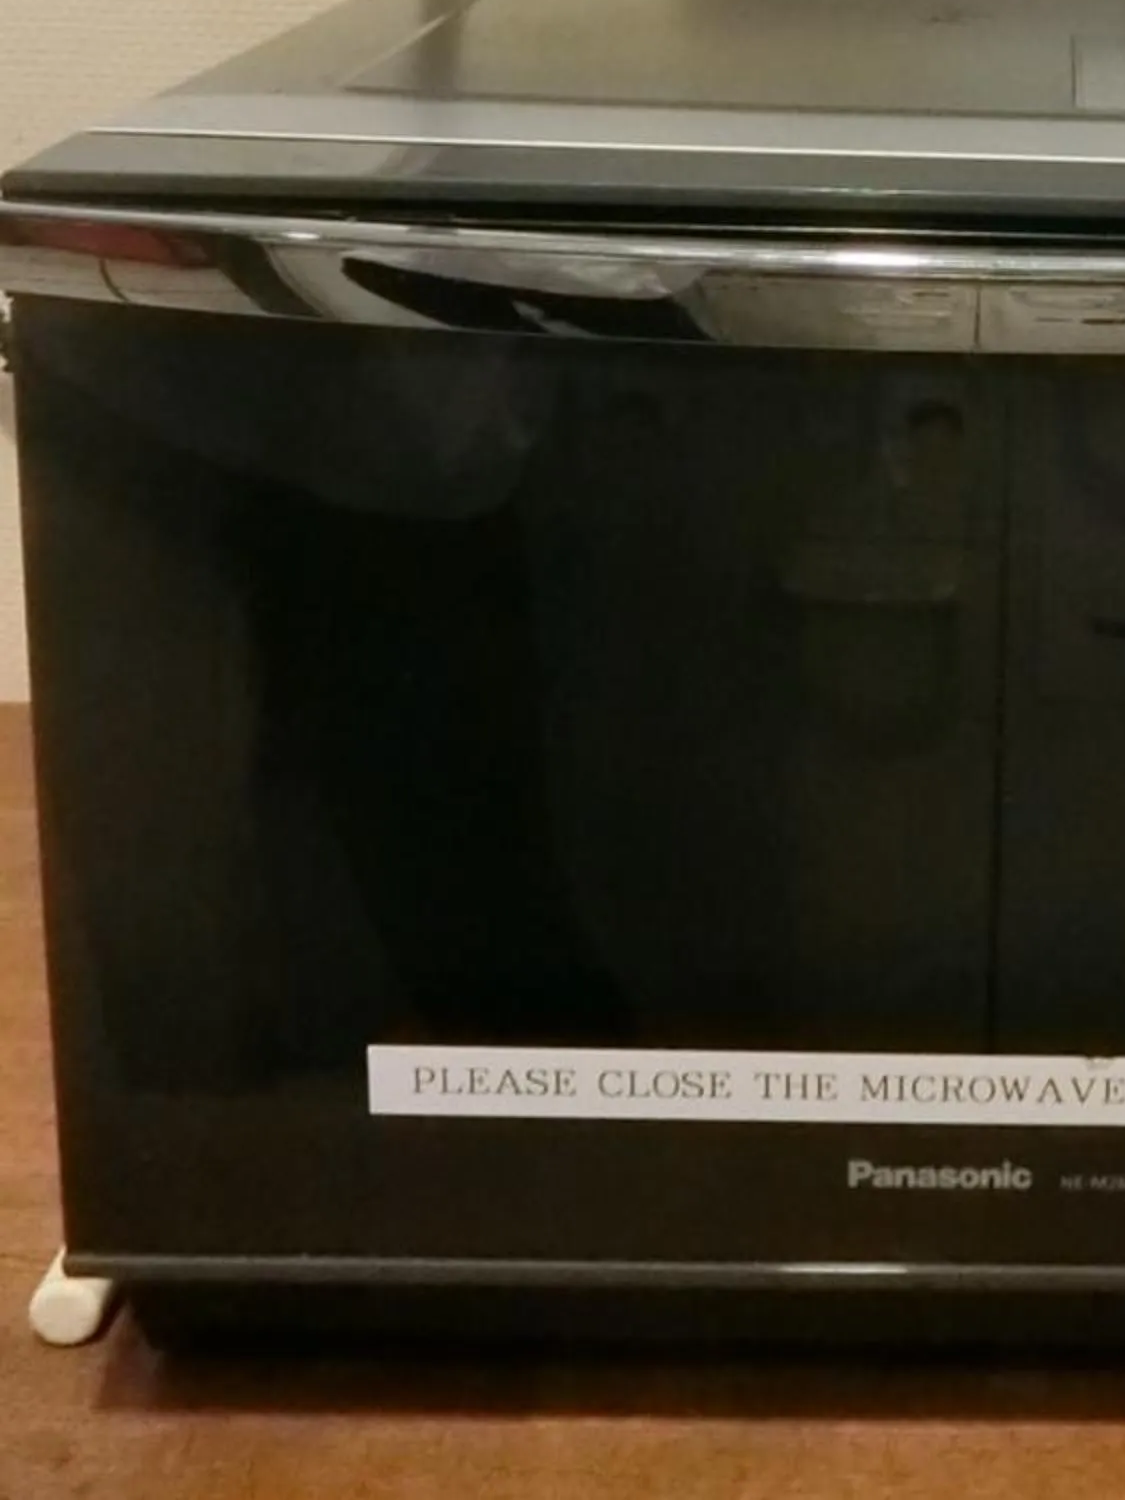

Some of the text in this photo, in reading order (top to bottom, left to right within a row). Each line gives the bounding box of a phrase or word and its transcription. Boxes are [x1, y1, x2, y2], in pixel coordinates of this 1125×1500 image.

[412, 1066, 577, 1097] PLEASE
[597, 1069, 732, 1100] CLOSE
[753, 1072, 838, 1101] THE
[847, 1158, 1033, 1190] Panasonic
